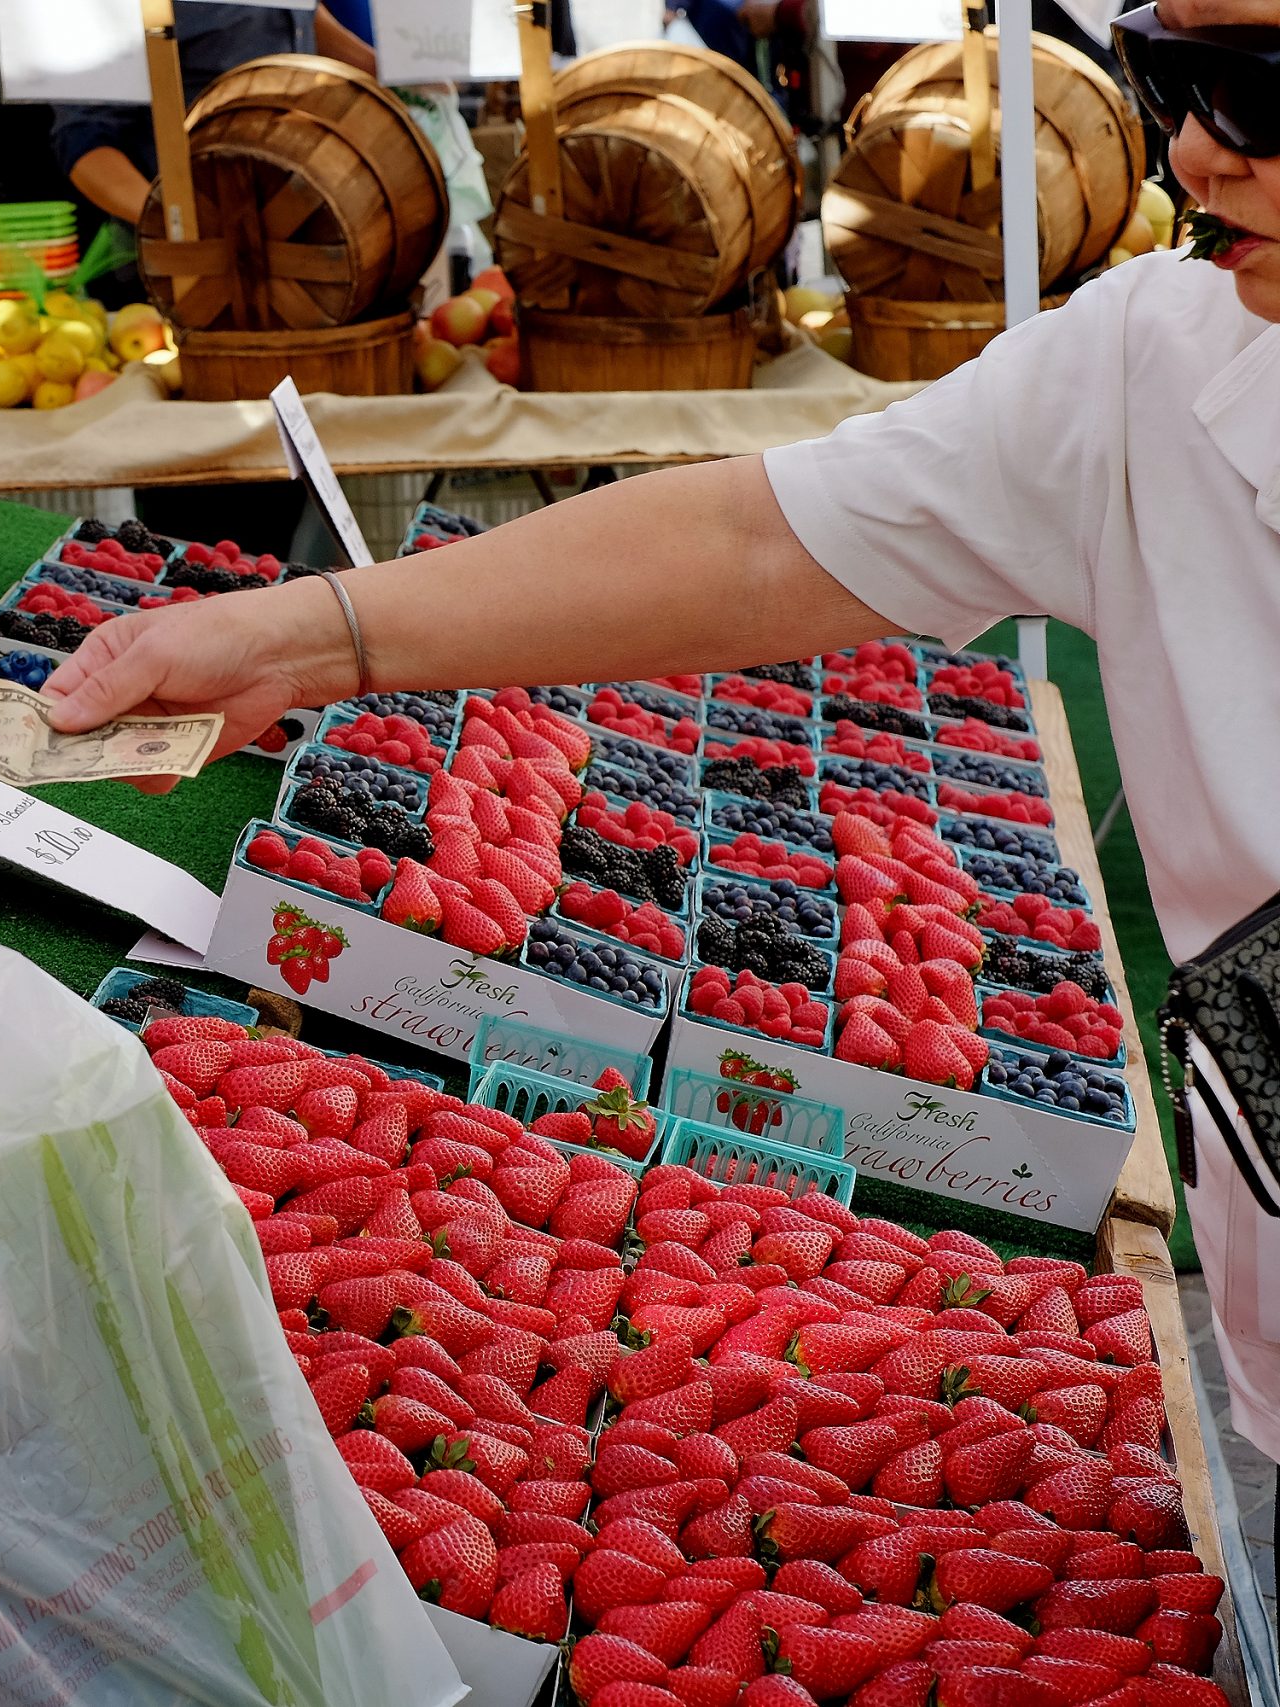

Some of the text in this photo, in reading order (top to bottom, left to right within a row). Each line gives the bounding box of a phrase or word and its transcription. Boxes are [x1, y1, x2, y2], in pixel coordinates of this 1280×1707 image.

[440, 958, 519, 1006] Fresh
[850, 1112, 953, 1151] California
[896, 1091, 979, 1132] Fresh
[203, 1425, 293, 1502] RECYCLING
